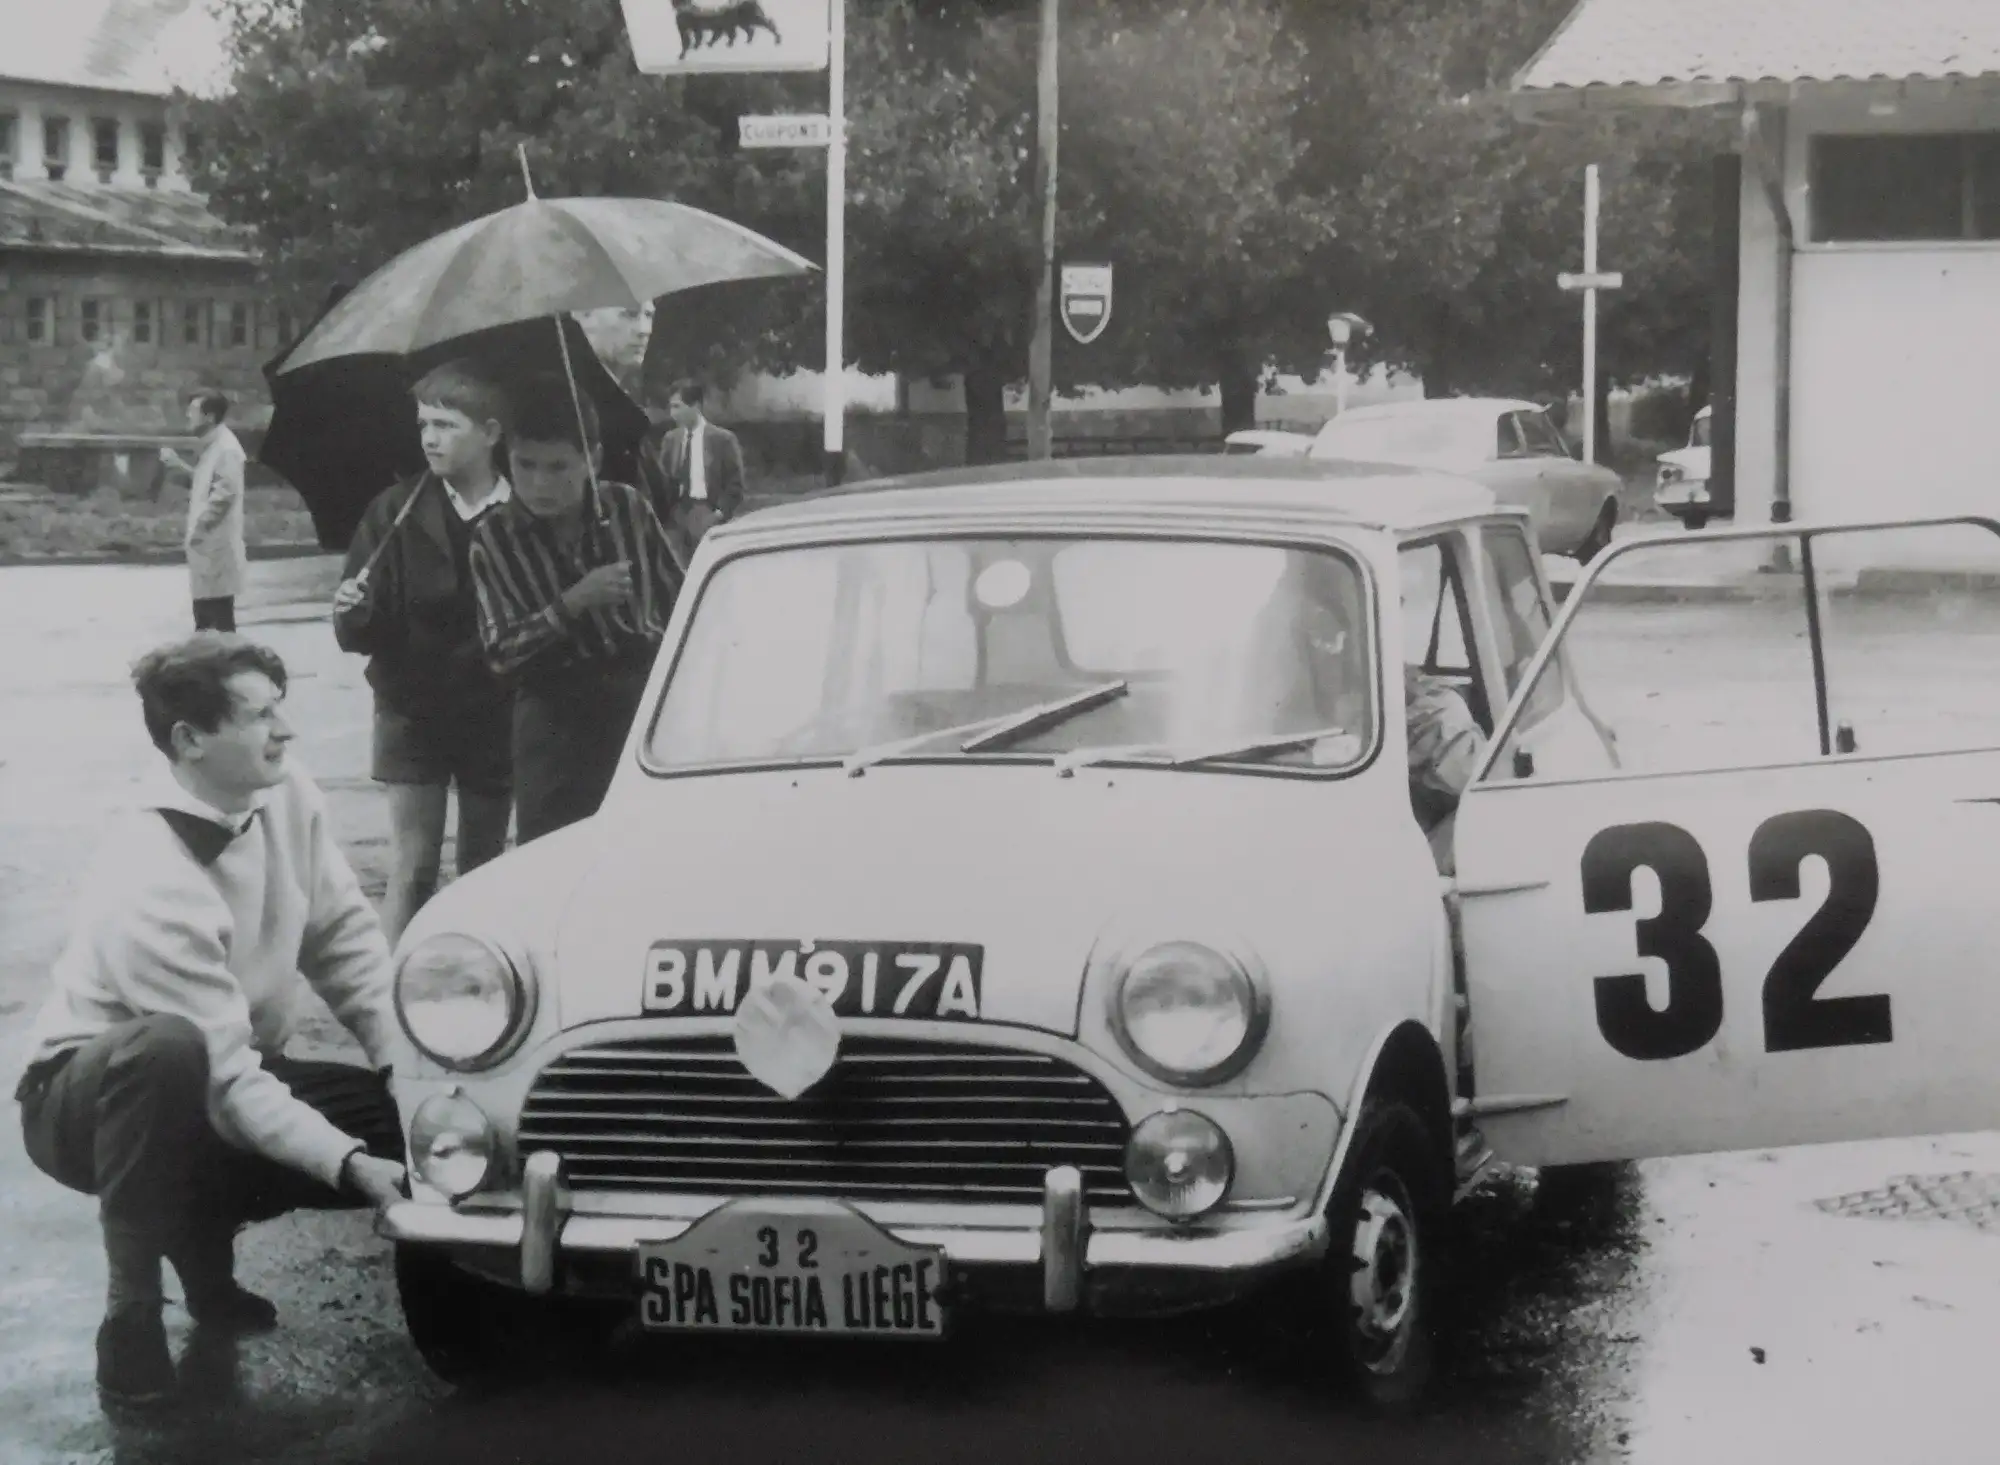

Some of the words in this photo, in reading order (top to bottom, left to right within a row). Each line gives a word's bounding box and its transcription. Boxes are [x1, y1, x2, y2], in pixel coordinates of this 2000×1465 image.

[1581, 808, 1893, 1061] 32
[646, 1257, 718, 1324] SPA
[729, 1273, 828, 1329] SOFIA
[843, 1258, 936, 1330] LIEGE
